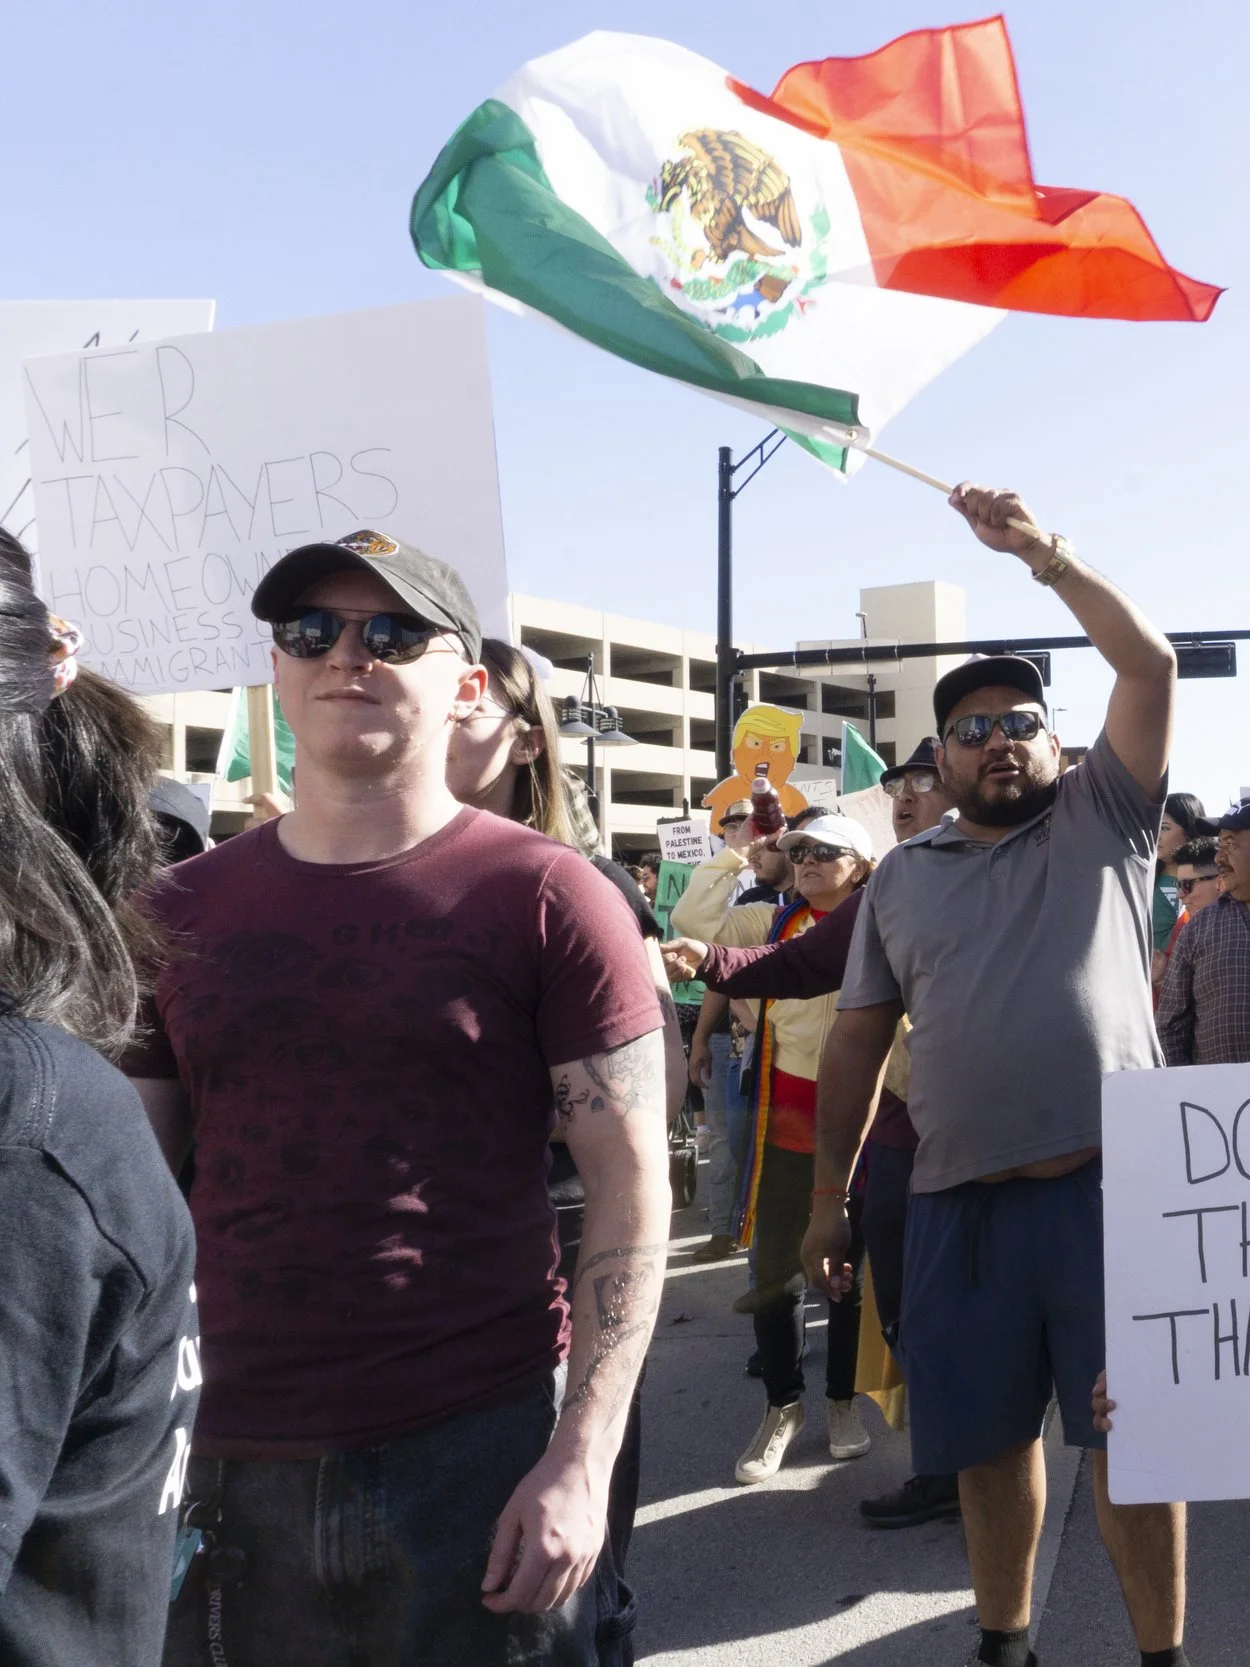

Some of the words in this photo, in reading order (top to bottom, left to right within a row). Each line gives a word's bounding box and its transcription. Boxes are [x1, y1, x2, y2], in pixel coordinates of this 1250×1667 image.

[24, 350, 140, 463] WE
[155, 345, 212, 457] R
[40, 448, 399, 553] TAXPAYERS
[86, 639, 274, 686] MMIGRANT
[665, 836, 703, 848] PALESTINE
[672, 826, 692, 835] FROM
[666, 851, 676, 860] TO
